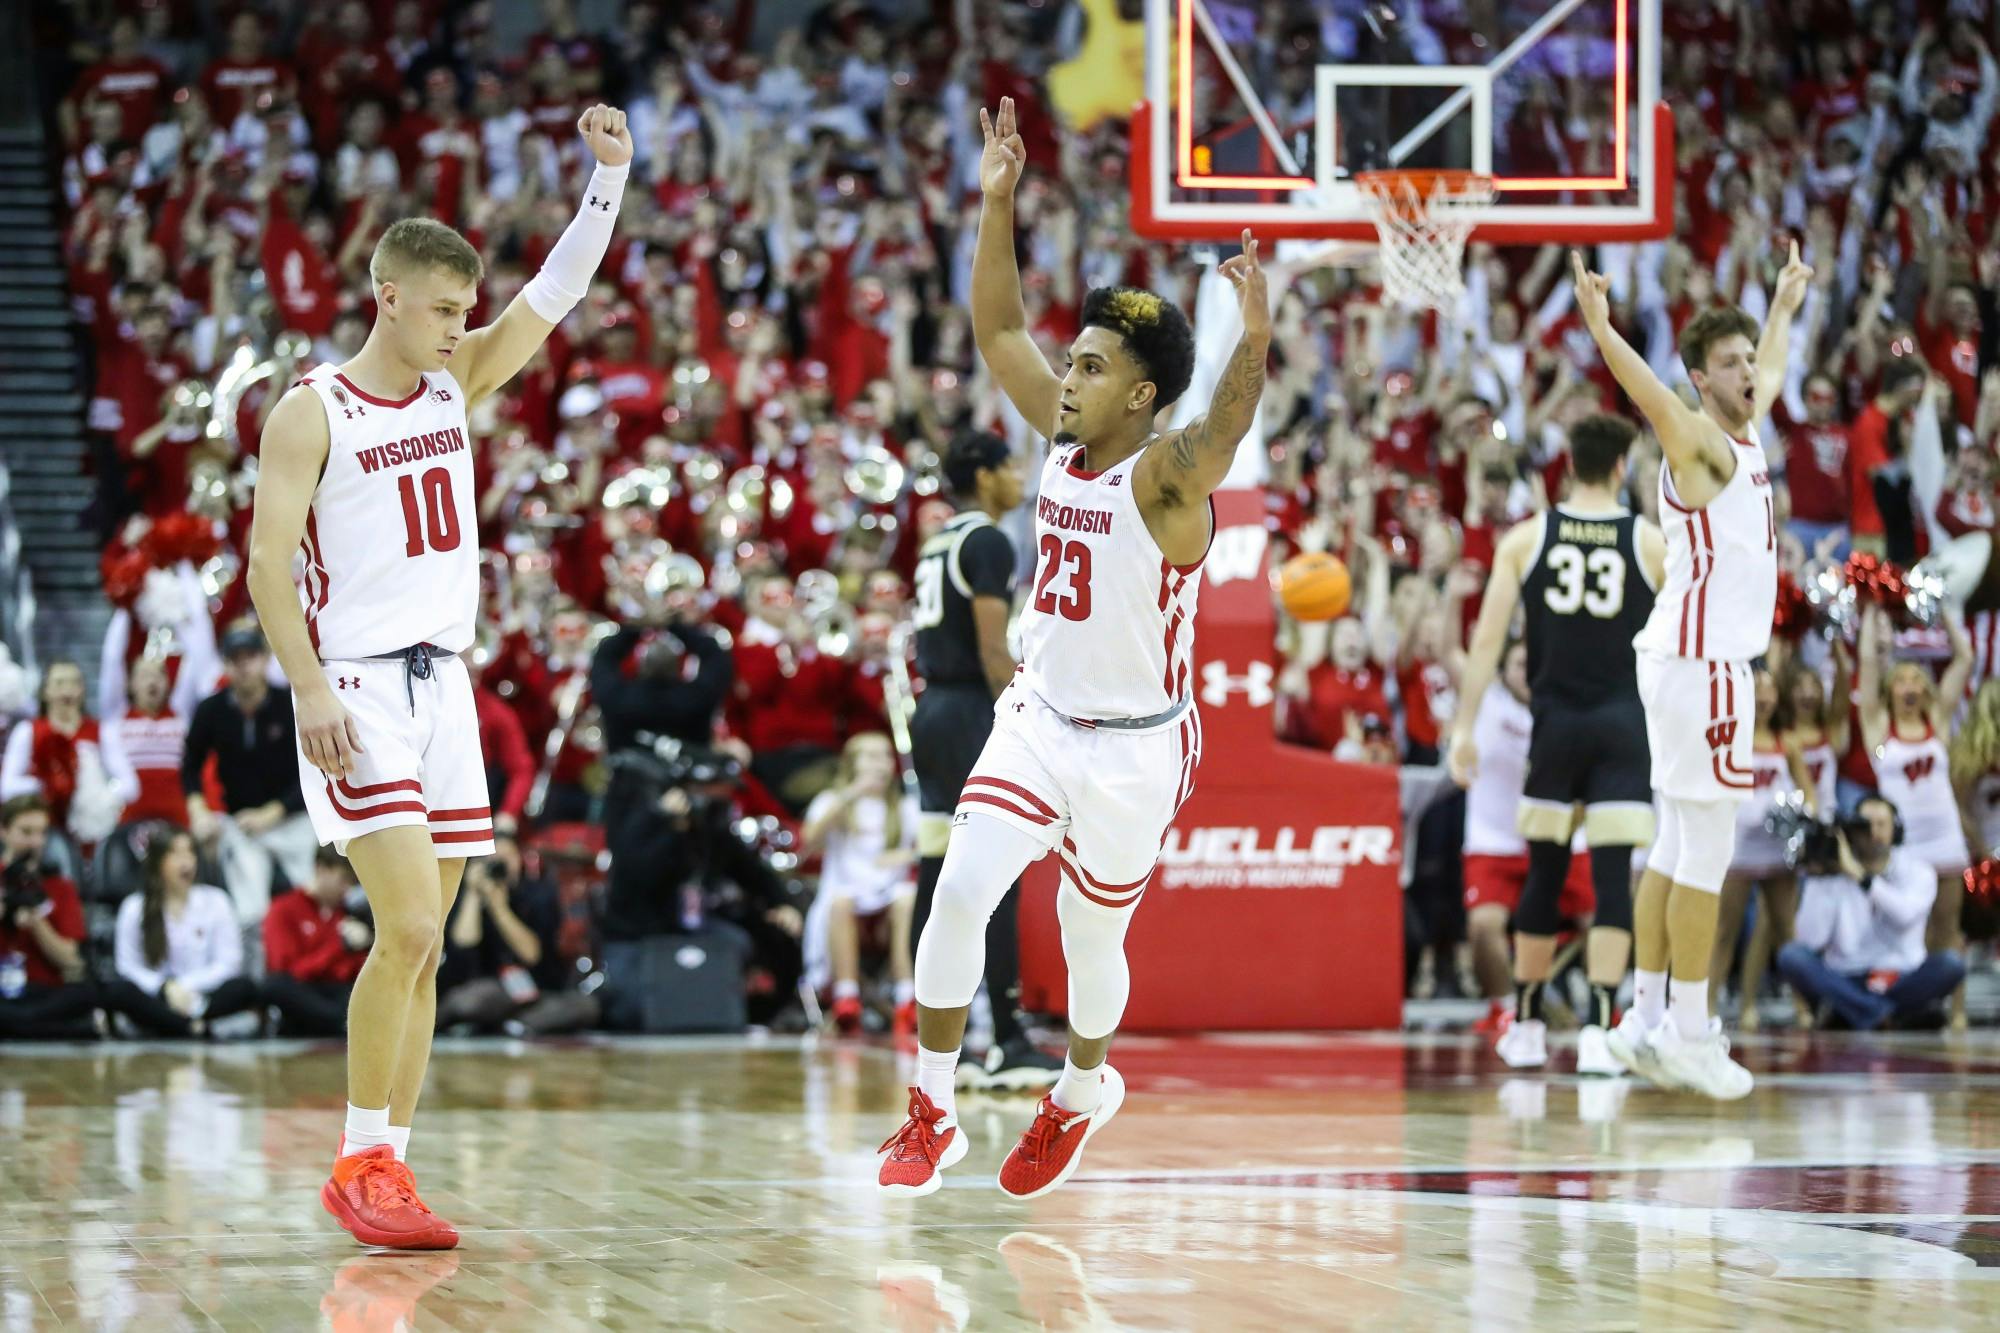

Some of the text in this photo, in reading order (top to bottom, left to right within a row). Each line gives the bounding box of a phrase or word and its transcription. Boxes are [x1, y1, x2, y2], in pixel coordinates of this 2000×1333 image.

[356, 427, 465, 474] WISCONSIN
[398, 467, 461, 558] 10
[1038, 495, 1114, 535] WSCONSIN
[1559, 520, 1618, 547] MARSH
[1034, 533, 1092, 622] 23
[1544, 542, 1627, 619] 33
[1705, 720, 1738, 751] W
[1157, 826, 1395, 866] UELLER
[1247, 866, 1344, 889] MEDICINE
